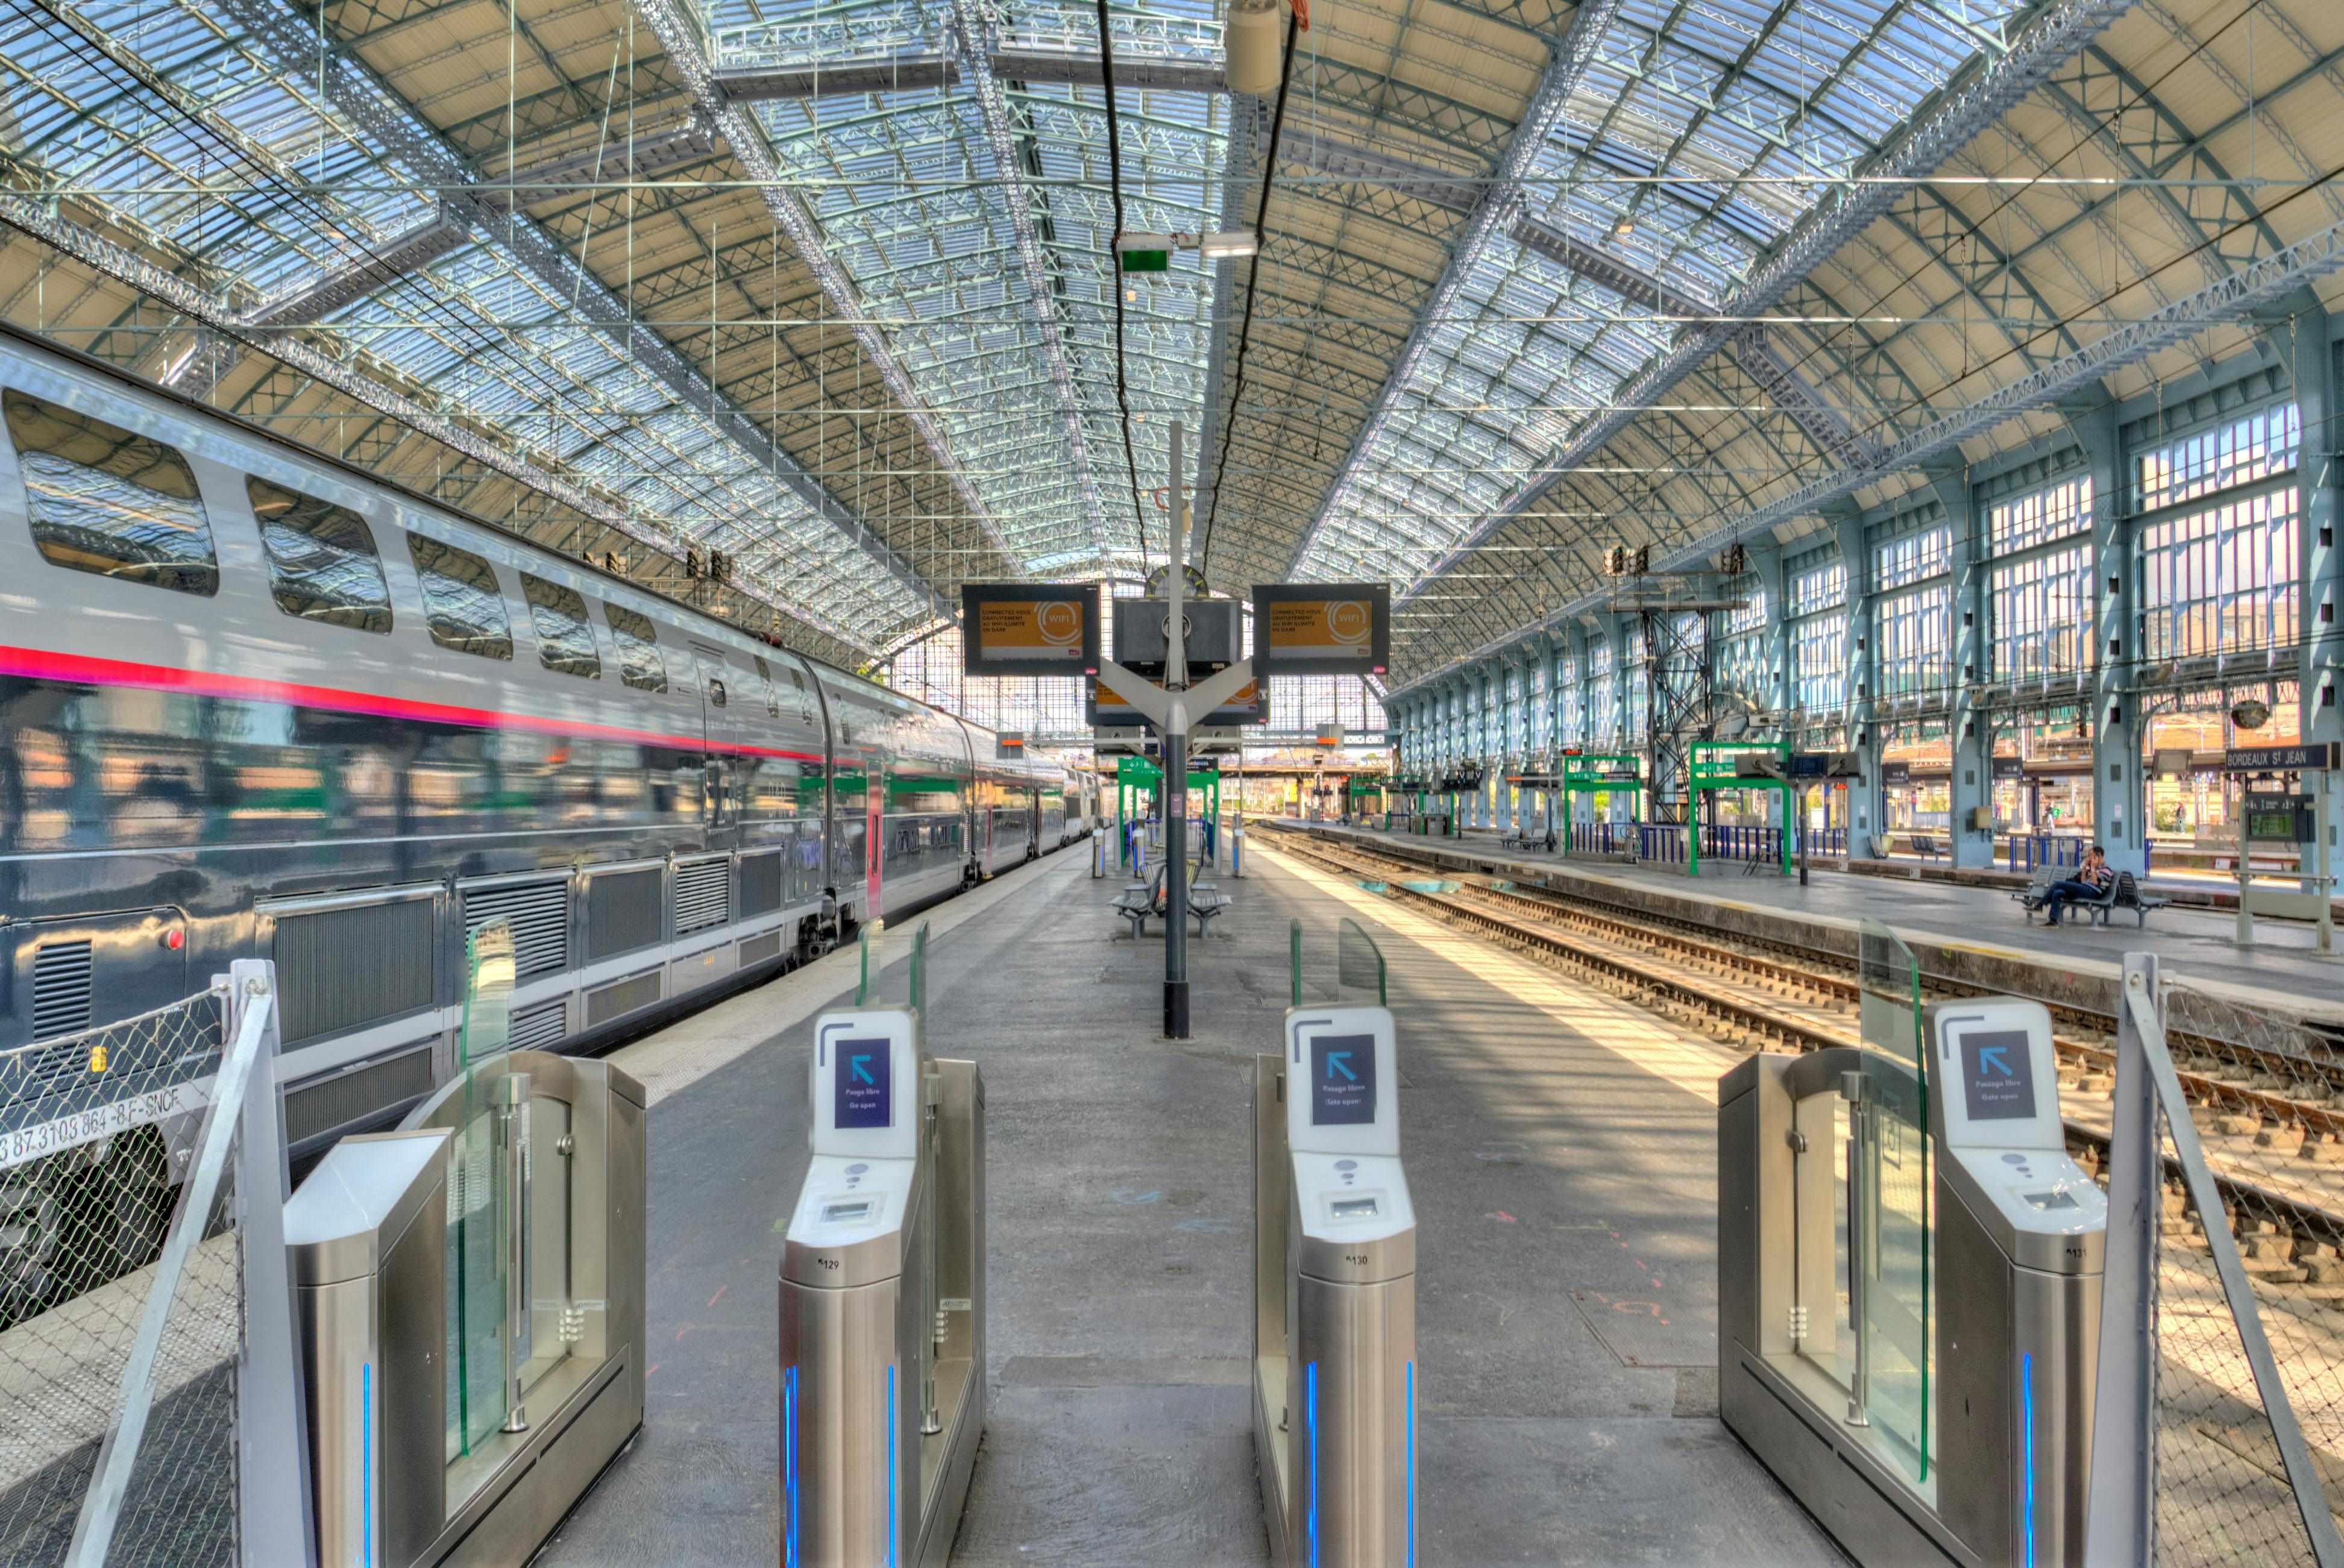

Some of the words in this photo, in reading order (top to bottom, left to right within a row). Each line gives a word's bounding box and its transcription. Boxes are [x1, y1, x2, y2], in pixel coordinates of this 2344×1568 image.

[2227, 753, 2268, 767] BORDEAUX
[2285, 751, 2307, 765] JEAN
[13, 1129, 33, 1157] 87
[824, 1259, 840, 1270] 129
[1352, 1255, 1368, 1265] 130
